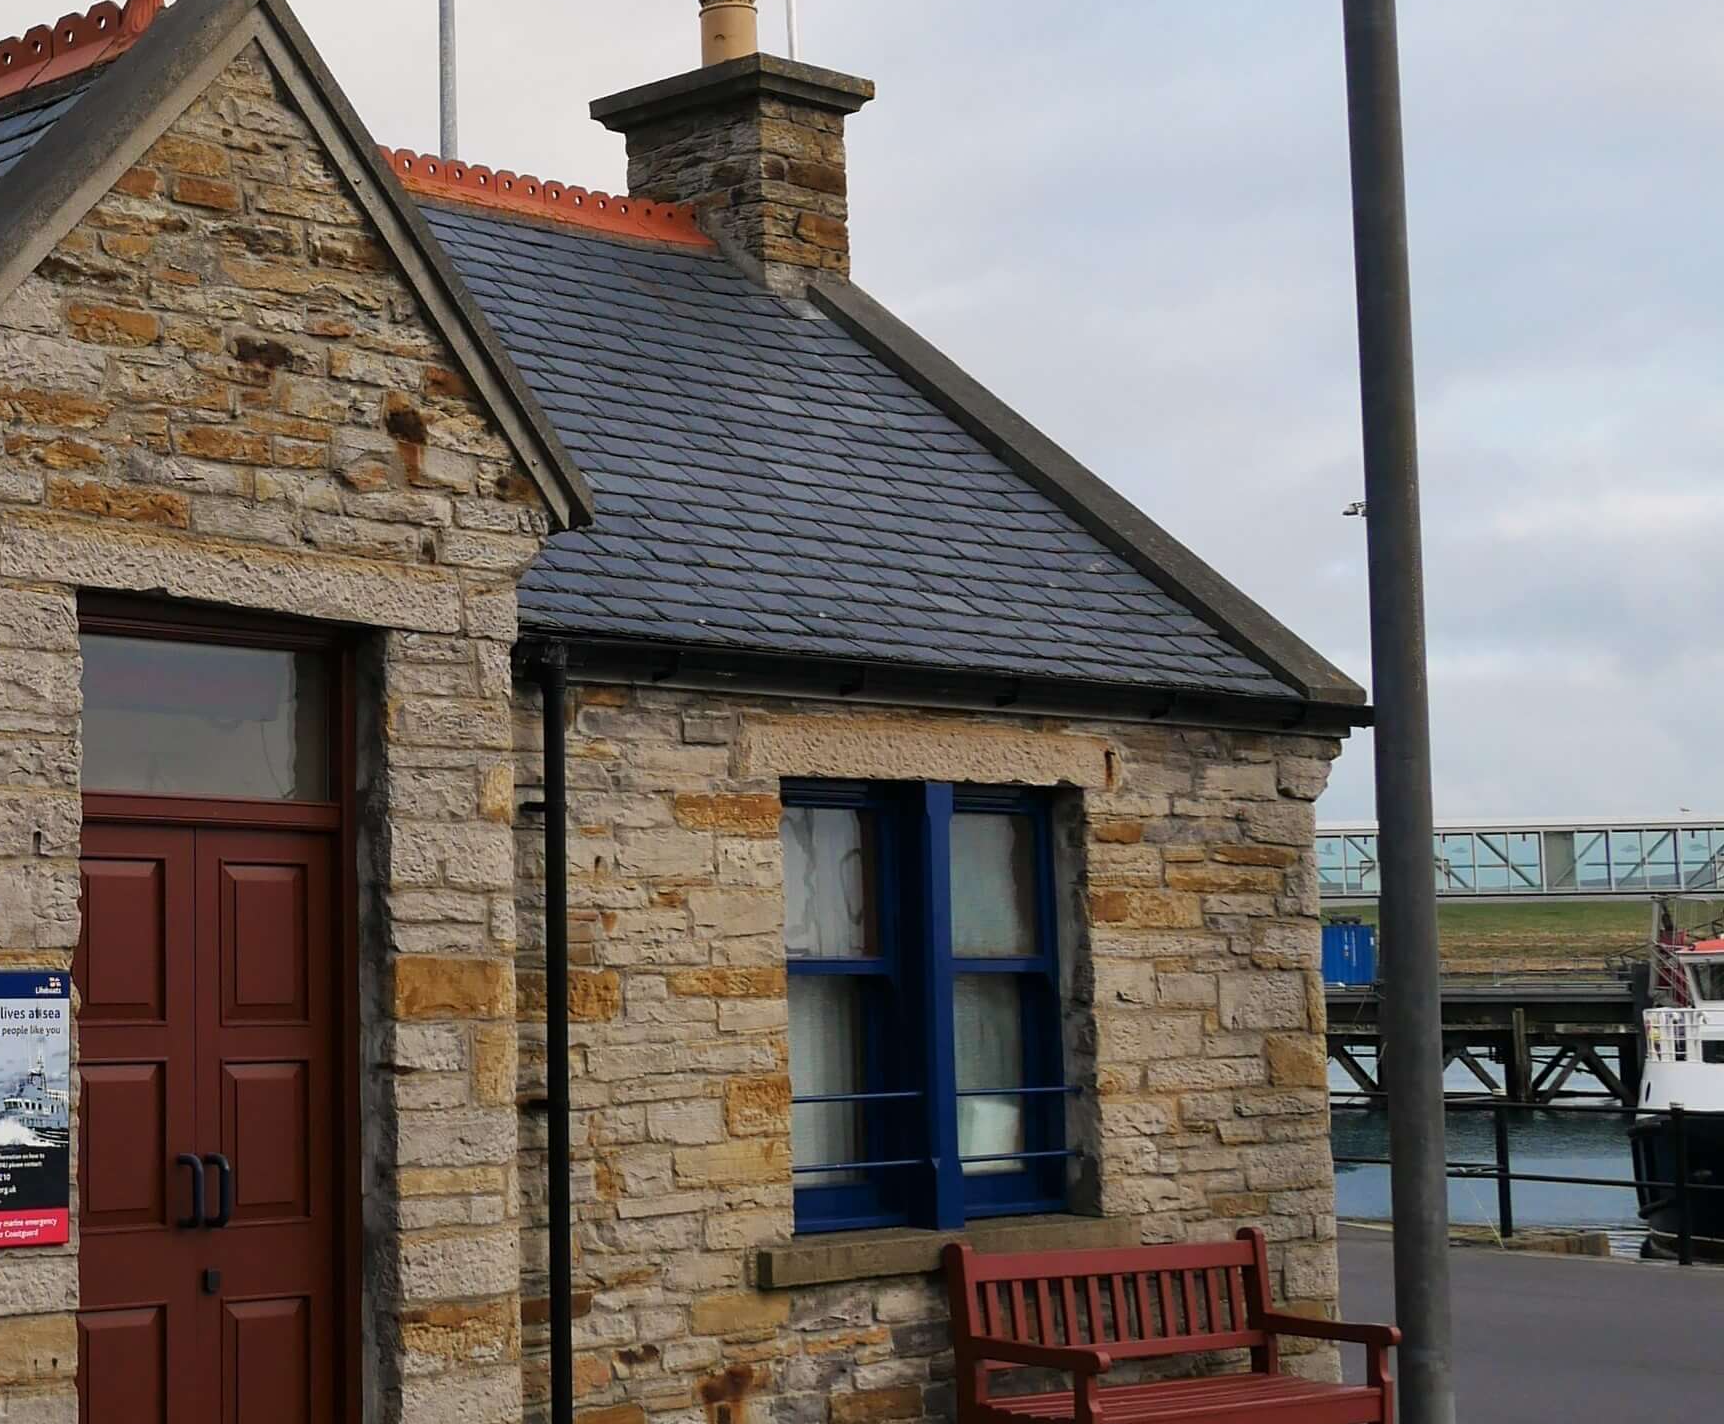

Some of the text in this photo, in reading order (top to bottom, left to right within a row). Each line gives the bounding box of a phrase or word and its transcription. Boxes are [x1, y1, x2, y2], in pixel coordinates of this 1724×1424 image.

[0, 1006, 26, 1020] lives
[28, 1007, 40, 1019] at
[43, 1009, 61, 1019] sea
[1, 1025, 29, 1037] people
[30, 1024, 44, 1034] like
[45, 1027, 61, 1037] you
